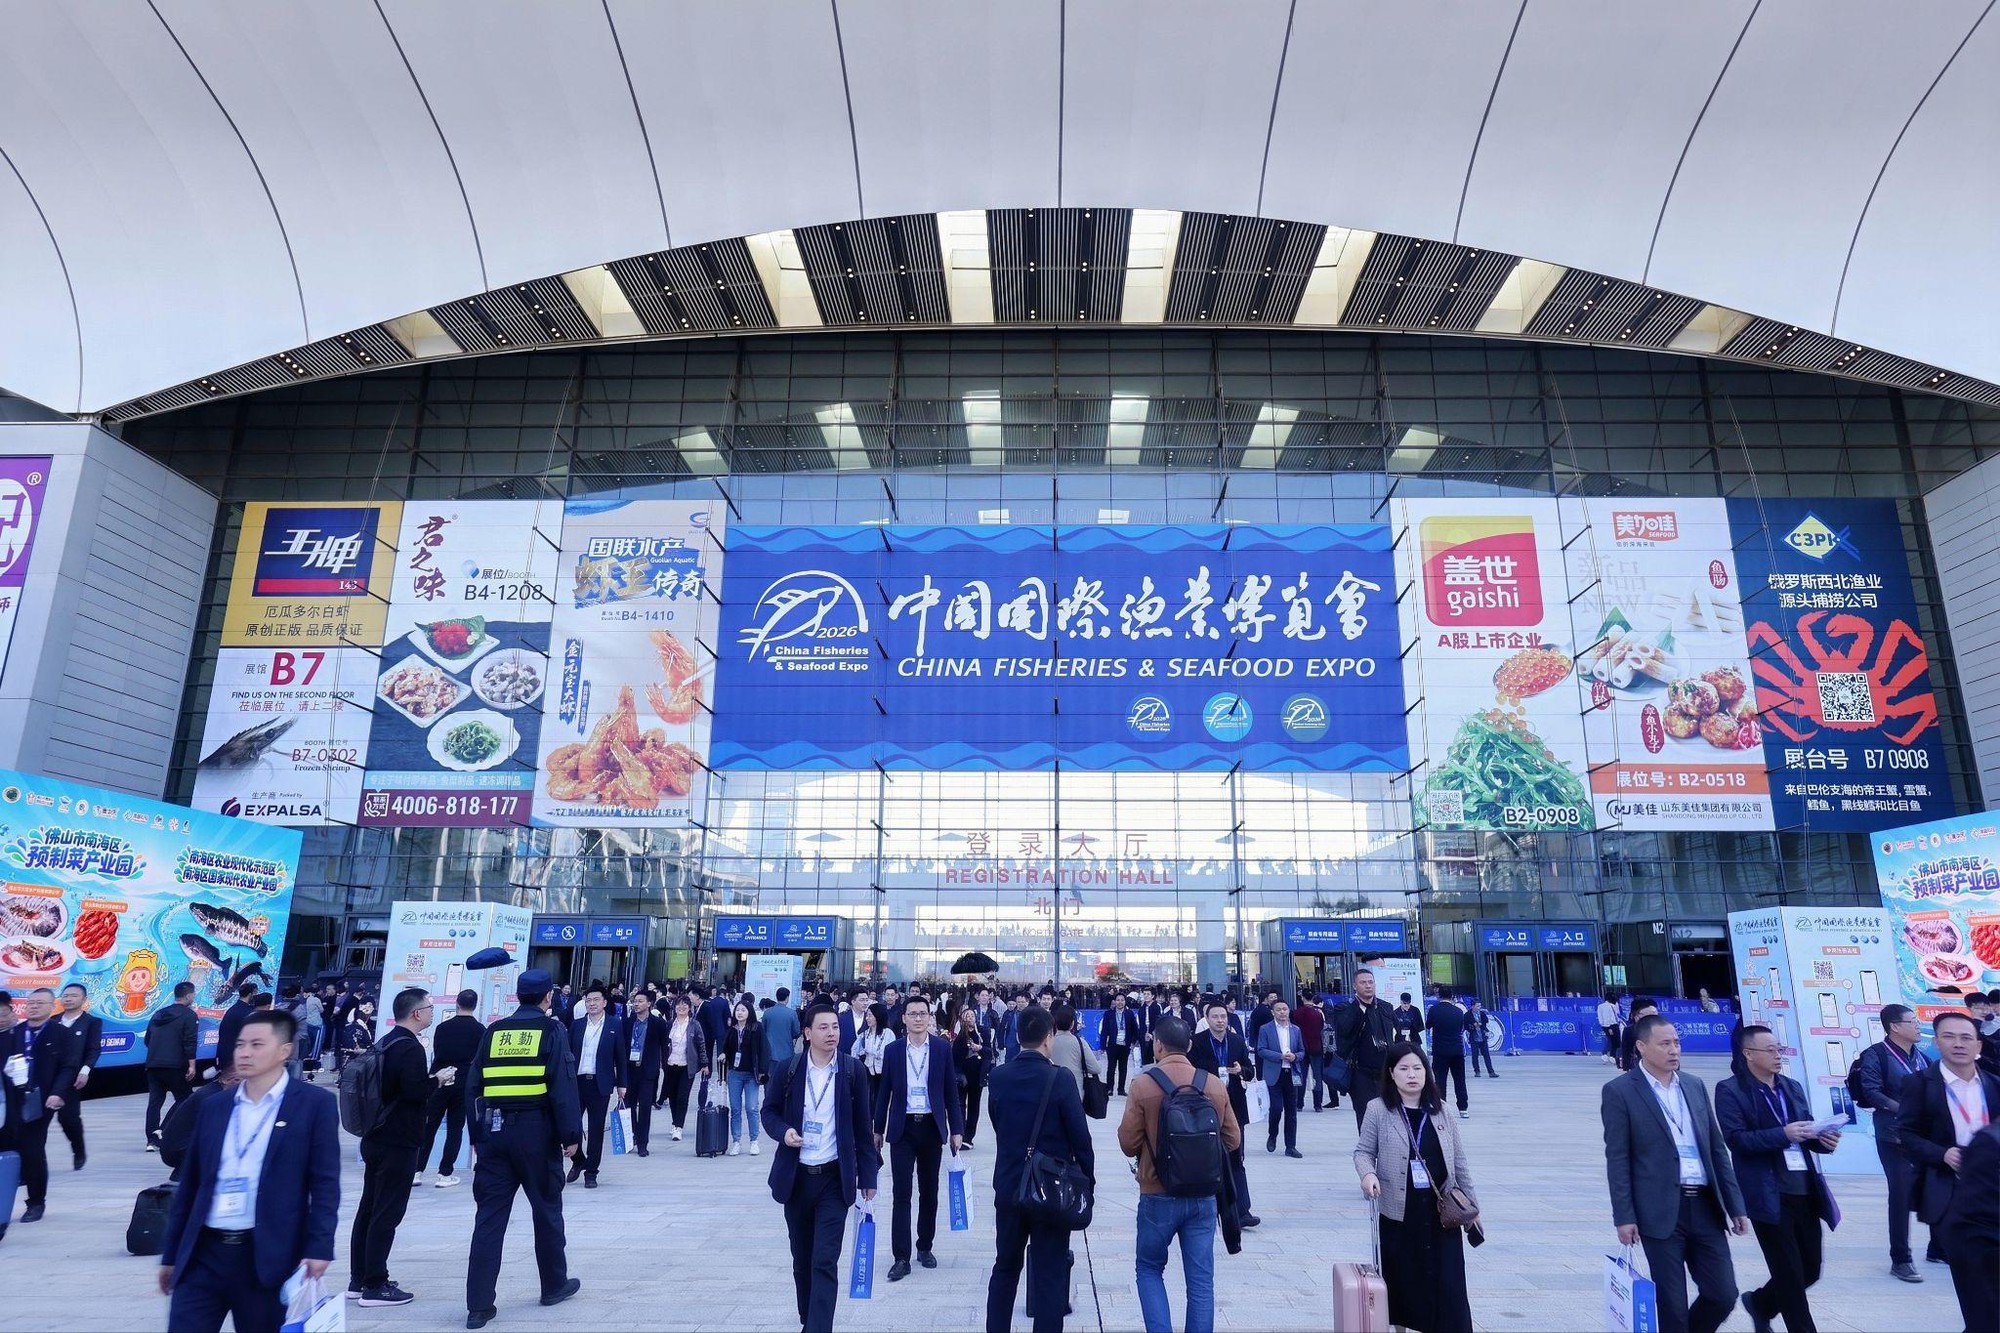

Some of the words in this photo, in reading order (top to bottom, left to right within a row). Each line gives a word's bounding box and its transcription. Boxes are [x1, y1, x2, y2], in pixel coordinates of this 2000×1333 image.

[264, 529, 363, 574] 王牌
[588, 538, 683, 557] 国联水产
[410, 516, 451, 601] 君之味
[1443, 555, 1518, 585] 盖世
[653, 568, 703, 597] 传奇
[1769, 574, 1883, 590] 俄罗斯西北渔业
[464, 585, 543, 600] B4-1208
[1447, 586, 1519, 616] gaishi
[1779, 593, 1878, 608] 源头捕捞公司
[264, 605, 350, 619] 厄瓜多尔白虾
[622, 611, 674, 620] B4-1410
[244, 623, 301, 637] 原创正版
[306, 623, 363, 637] 品质保证
[816, 626, 857, 639] 2026
[1437, 632, 1542, 649] A股上市企业
[775, 645, 809, 656] China
[813, 645, 869, 656] Fisheries
[244, 664, 268, 675] 展馆
[270, 652, 325, 685] B7
[775, 662, 783, 671] &
[787, 661, 836, 671] Seafood
[839, 662, 869, 673] Expo
[898, 658, 981, 677] CHINA
[994, 658, 1128, 678] FISHERIES
[1138, 658, 1155, 677] &
[1167, 658, 1294, 678] SEAFOOD
[1305, 658, 1376, 678] EXPO
[292, 749, 357, 761] B7-0302
[1784, 749, 1849, 770] 展台号
[1865, 749, 1885, 769] B7
[1889, 749, 1929, 769] 0908
[322, 763, 351, 773] Shrimp
[1679, 772, 1746, 787] B2-0518
[252, 792, 276, 800] 生产商
[245, 804, 322, 817] EXPALSA
[391, 796, 518, 815] 4006-818-177
[1633, 804, 1658, 816] 美佳
[1661, 803, 1762, 813] 山东美佳集团有限公司
[1504, 808, 1579, 824] B2-0908
[45, 827, 122, 854] 佛山市南海区
[966, 832, 1148, 857] 登录大厅
[25, 846, 134, 876] 预制菜产业园
[190, 850, 277, 876] 南海区农业现代化示范区
[1920, 856, 1982, 878] 佛山市南海区
[183, 865, 278, 891] 南海区国家现代农业产业园
[945, 869, 1107, 884] REGISTRATION
[1119, 869, 1174, 884] HALL
[1913, 868, 2000, 900] 预制菜产业园
[1034, 897, 1081, 916] 北门
[745, 926, 766, 934] 入口
[804, 926, 826, 935] 入口
[1061, 928, 1083, 937] GATE
[1652, 922, 1664, 935] N2
[1506, 932, 1527, 941] 入口
[1563, 932, 1584, 941] 入口
[499, 1032, 533, 1046] 执勤
